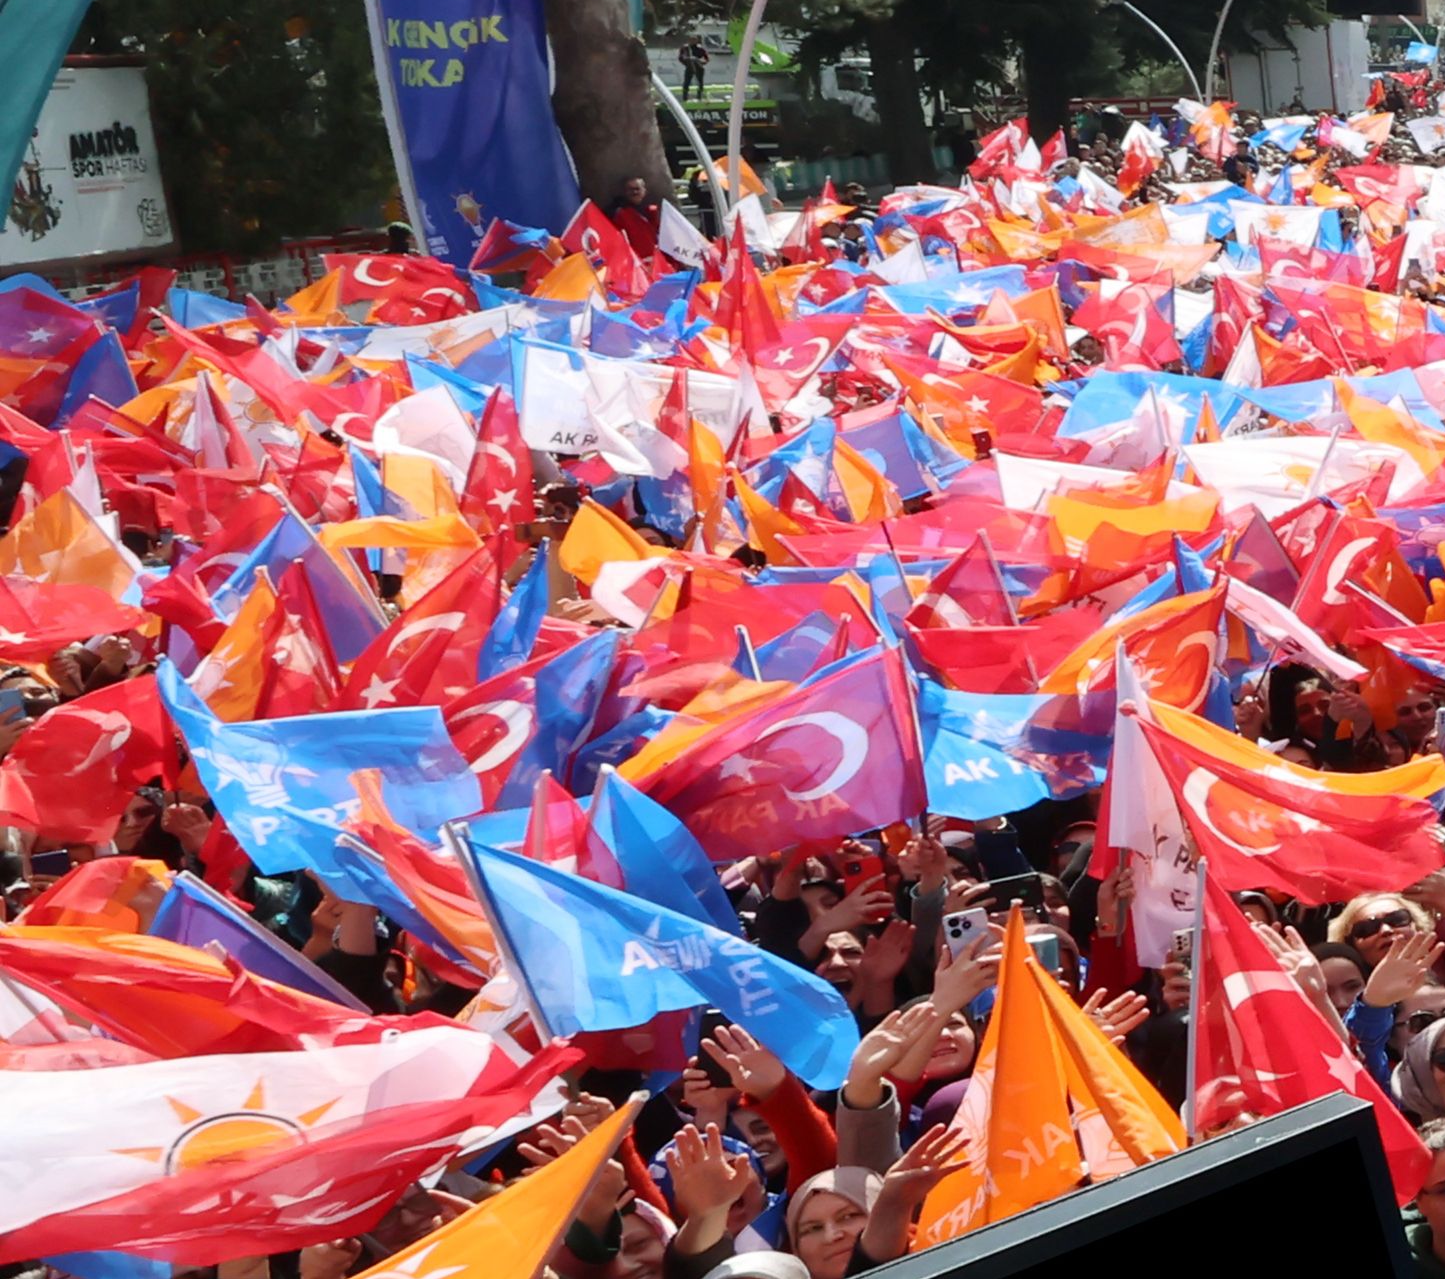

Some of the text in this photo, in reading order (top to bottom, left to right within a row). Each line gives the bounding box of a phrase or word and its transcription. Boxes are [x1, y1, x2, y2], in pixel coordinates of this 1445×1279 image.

[71, 158, 105, 178] SPOR
[550, 430, 579, 445] AK
[944, 756, 999, 787] AK
